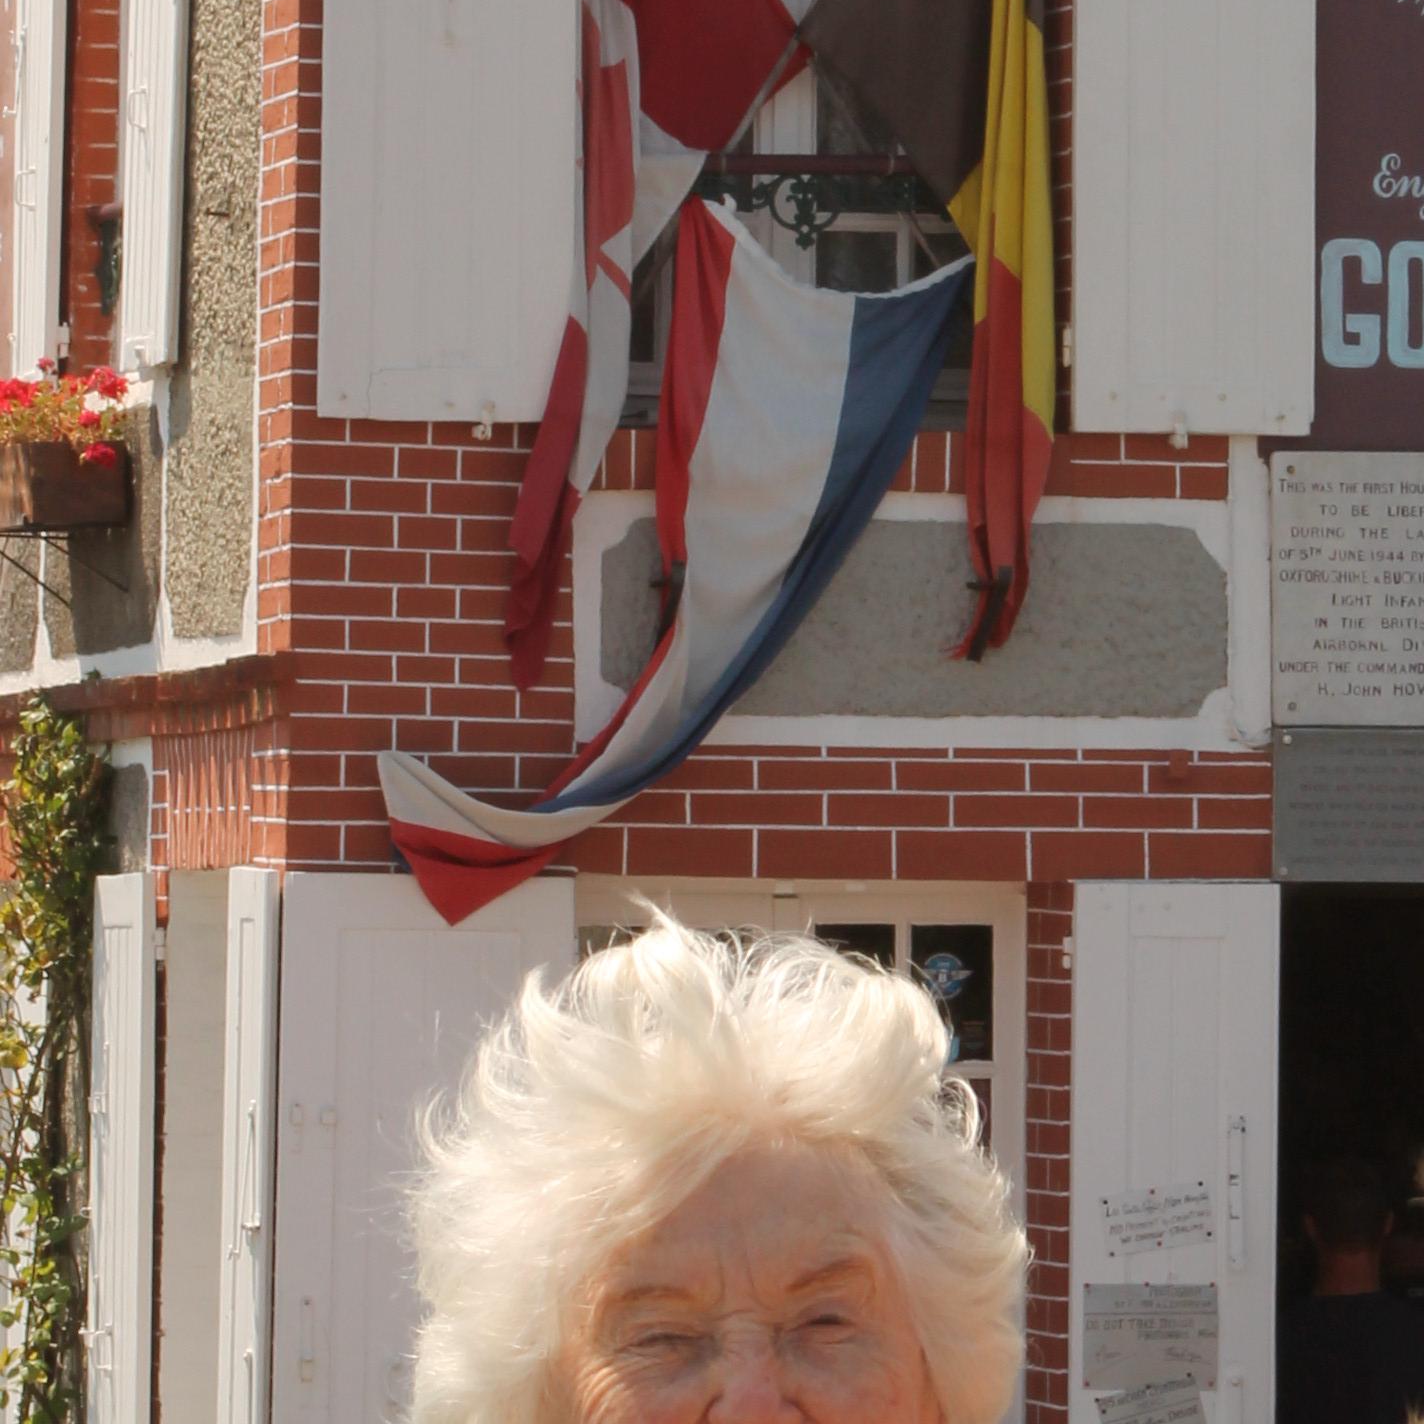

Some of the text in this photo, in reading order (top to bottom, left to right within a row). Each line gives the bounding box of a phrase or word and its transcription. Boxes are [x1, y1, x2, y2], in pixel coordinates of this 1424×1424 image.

[1311, 482, 1333, 493] WAS
[1339, 482, 1358, 494] THE
[1363, 482, 1395, 495] FIRST
[1320, 504, 1338, 516] TO
[1351, 505, 1369, 517] BE
[1291, 527, 1345, 538] DURING
[1360, 528, 1389, 540] THE
[1279, 549, 1295, 561] OF
[1328, 549, 1365, 562] JUNE
[1370, 550, 1404, 562] 1944
[1411, 550, 1424, 562] BY
[1331, 593, 1372, 607] LIGHT
[1315, 617, 1328, 628] IN
[1341, 618, 1365, 629] THE
[1313, 639, 1389, 653] AIRBORNE
[1279, 662, 1319, 673] UNDER
[1327, 662, 1350, 673] THE
[1343, 682, 1382, 697] JOHN
